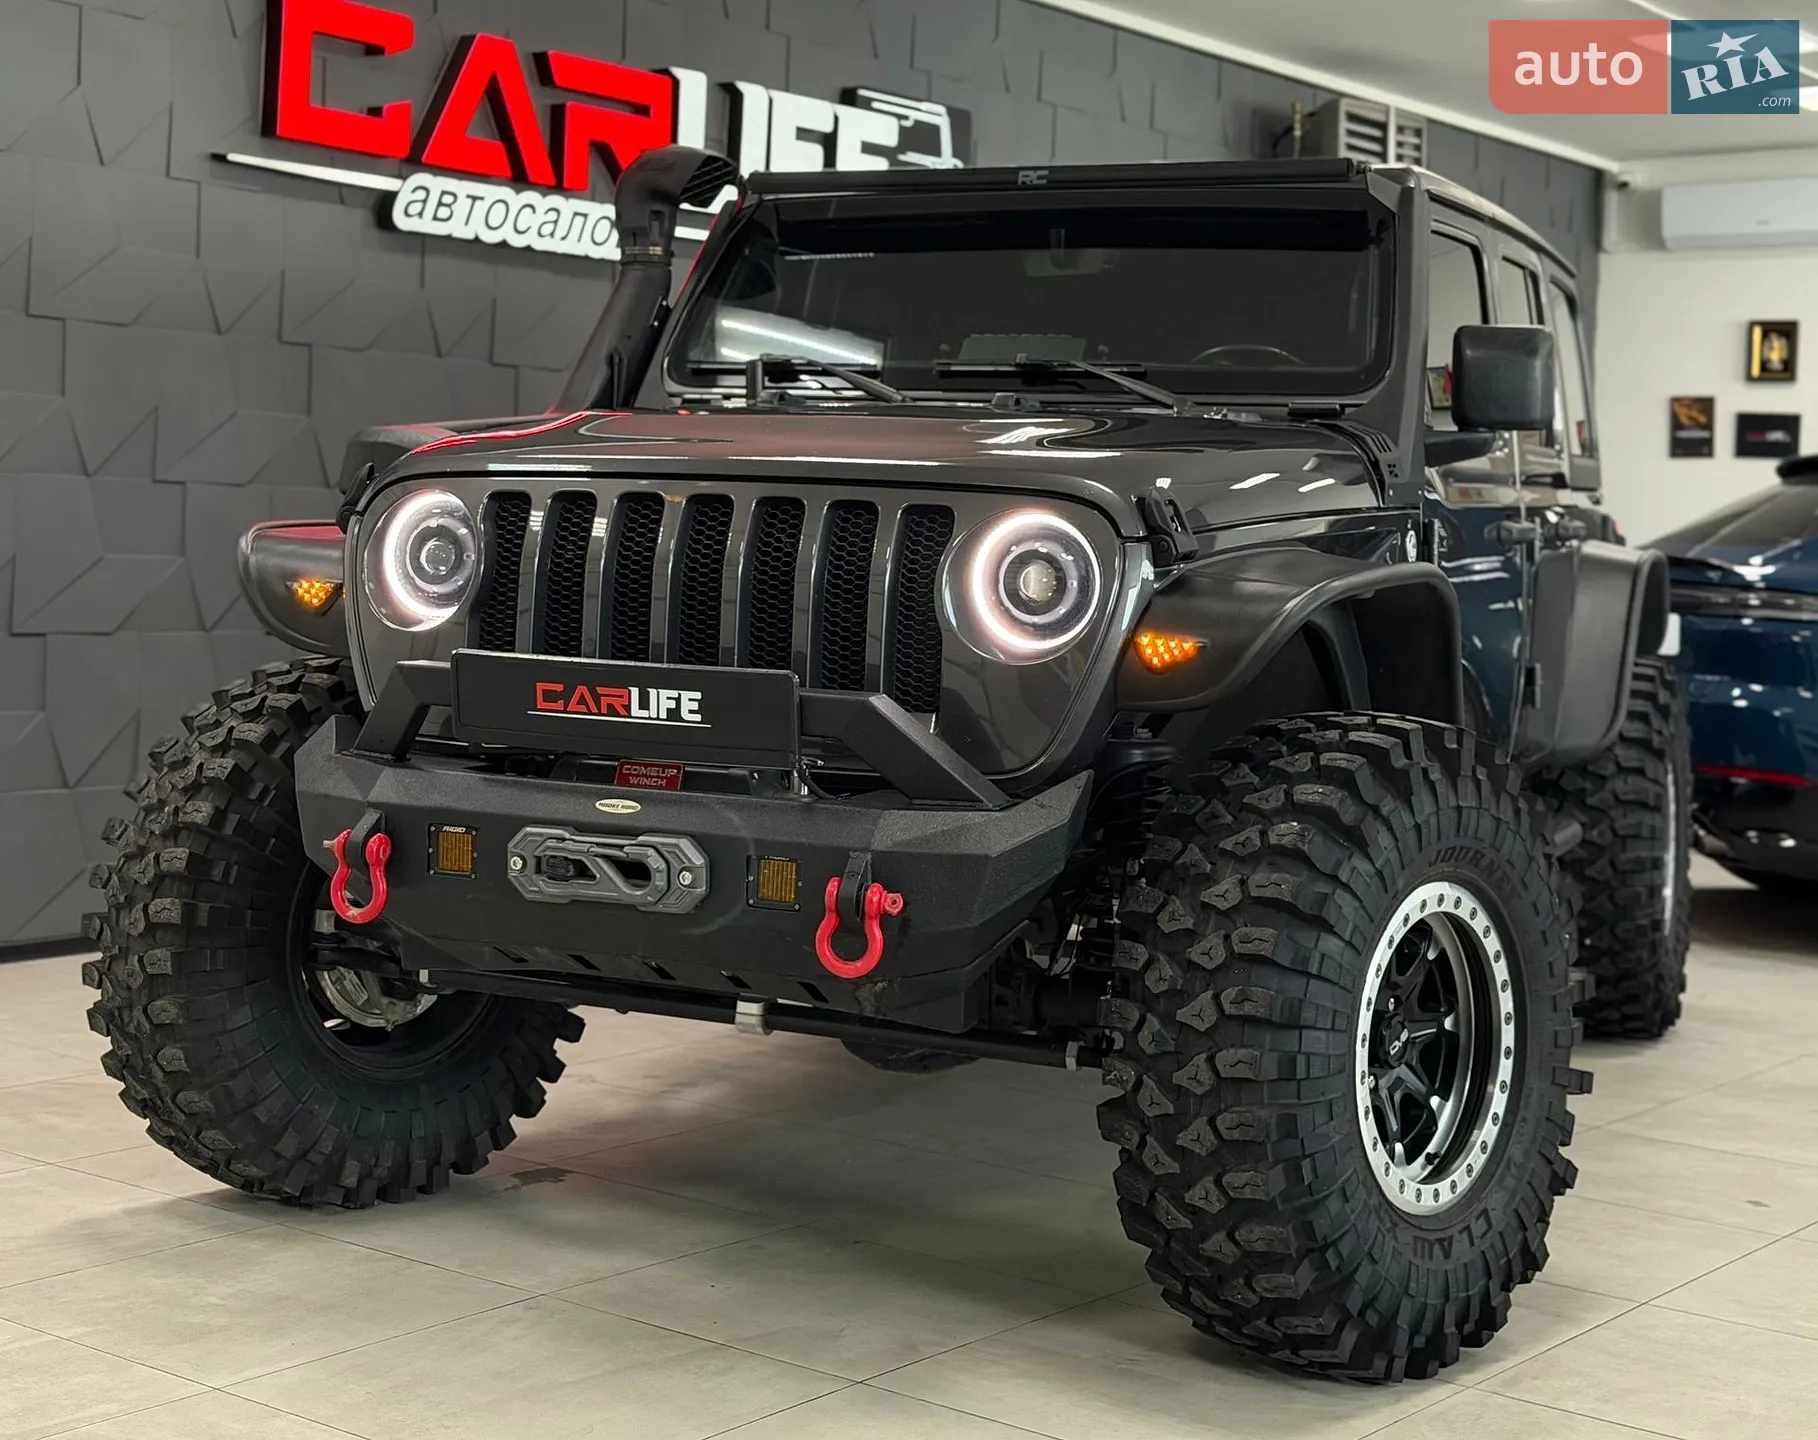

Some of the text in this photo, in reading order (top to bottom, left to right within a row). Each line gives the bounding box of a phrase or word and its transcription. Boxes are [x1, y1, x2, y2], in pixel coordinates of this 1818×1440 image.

[1018, 170, 1049, 185] RC
[403, 185, 617, 247] автосало
[535, 682, 702, 722] CARLIFE
[622, 765, 677, 777] COMEUP
[629, 776, 667, 787] WINCH
